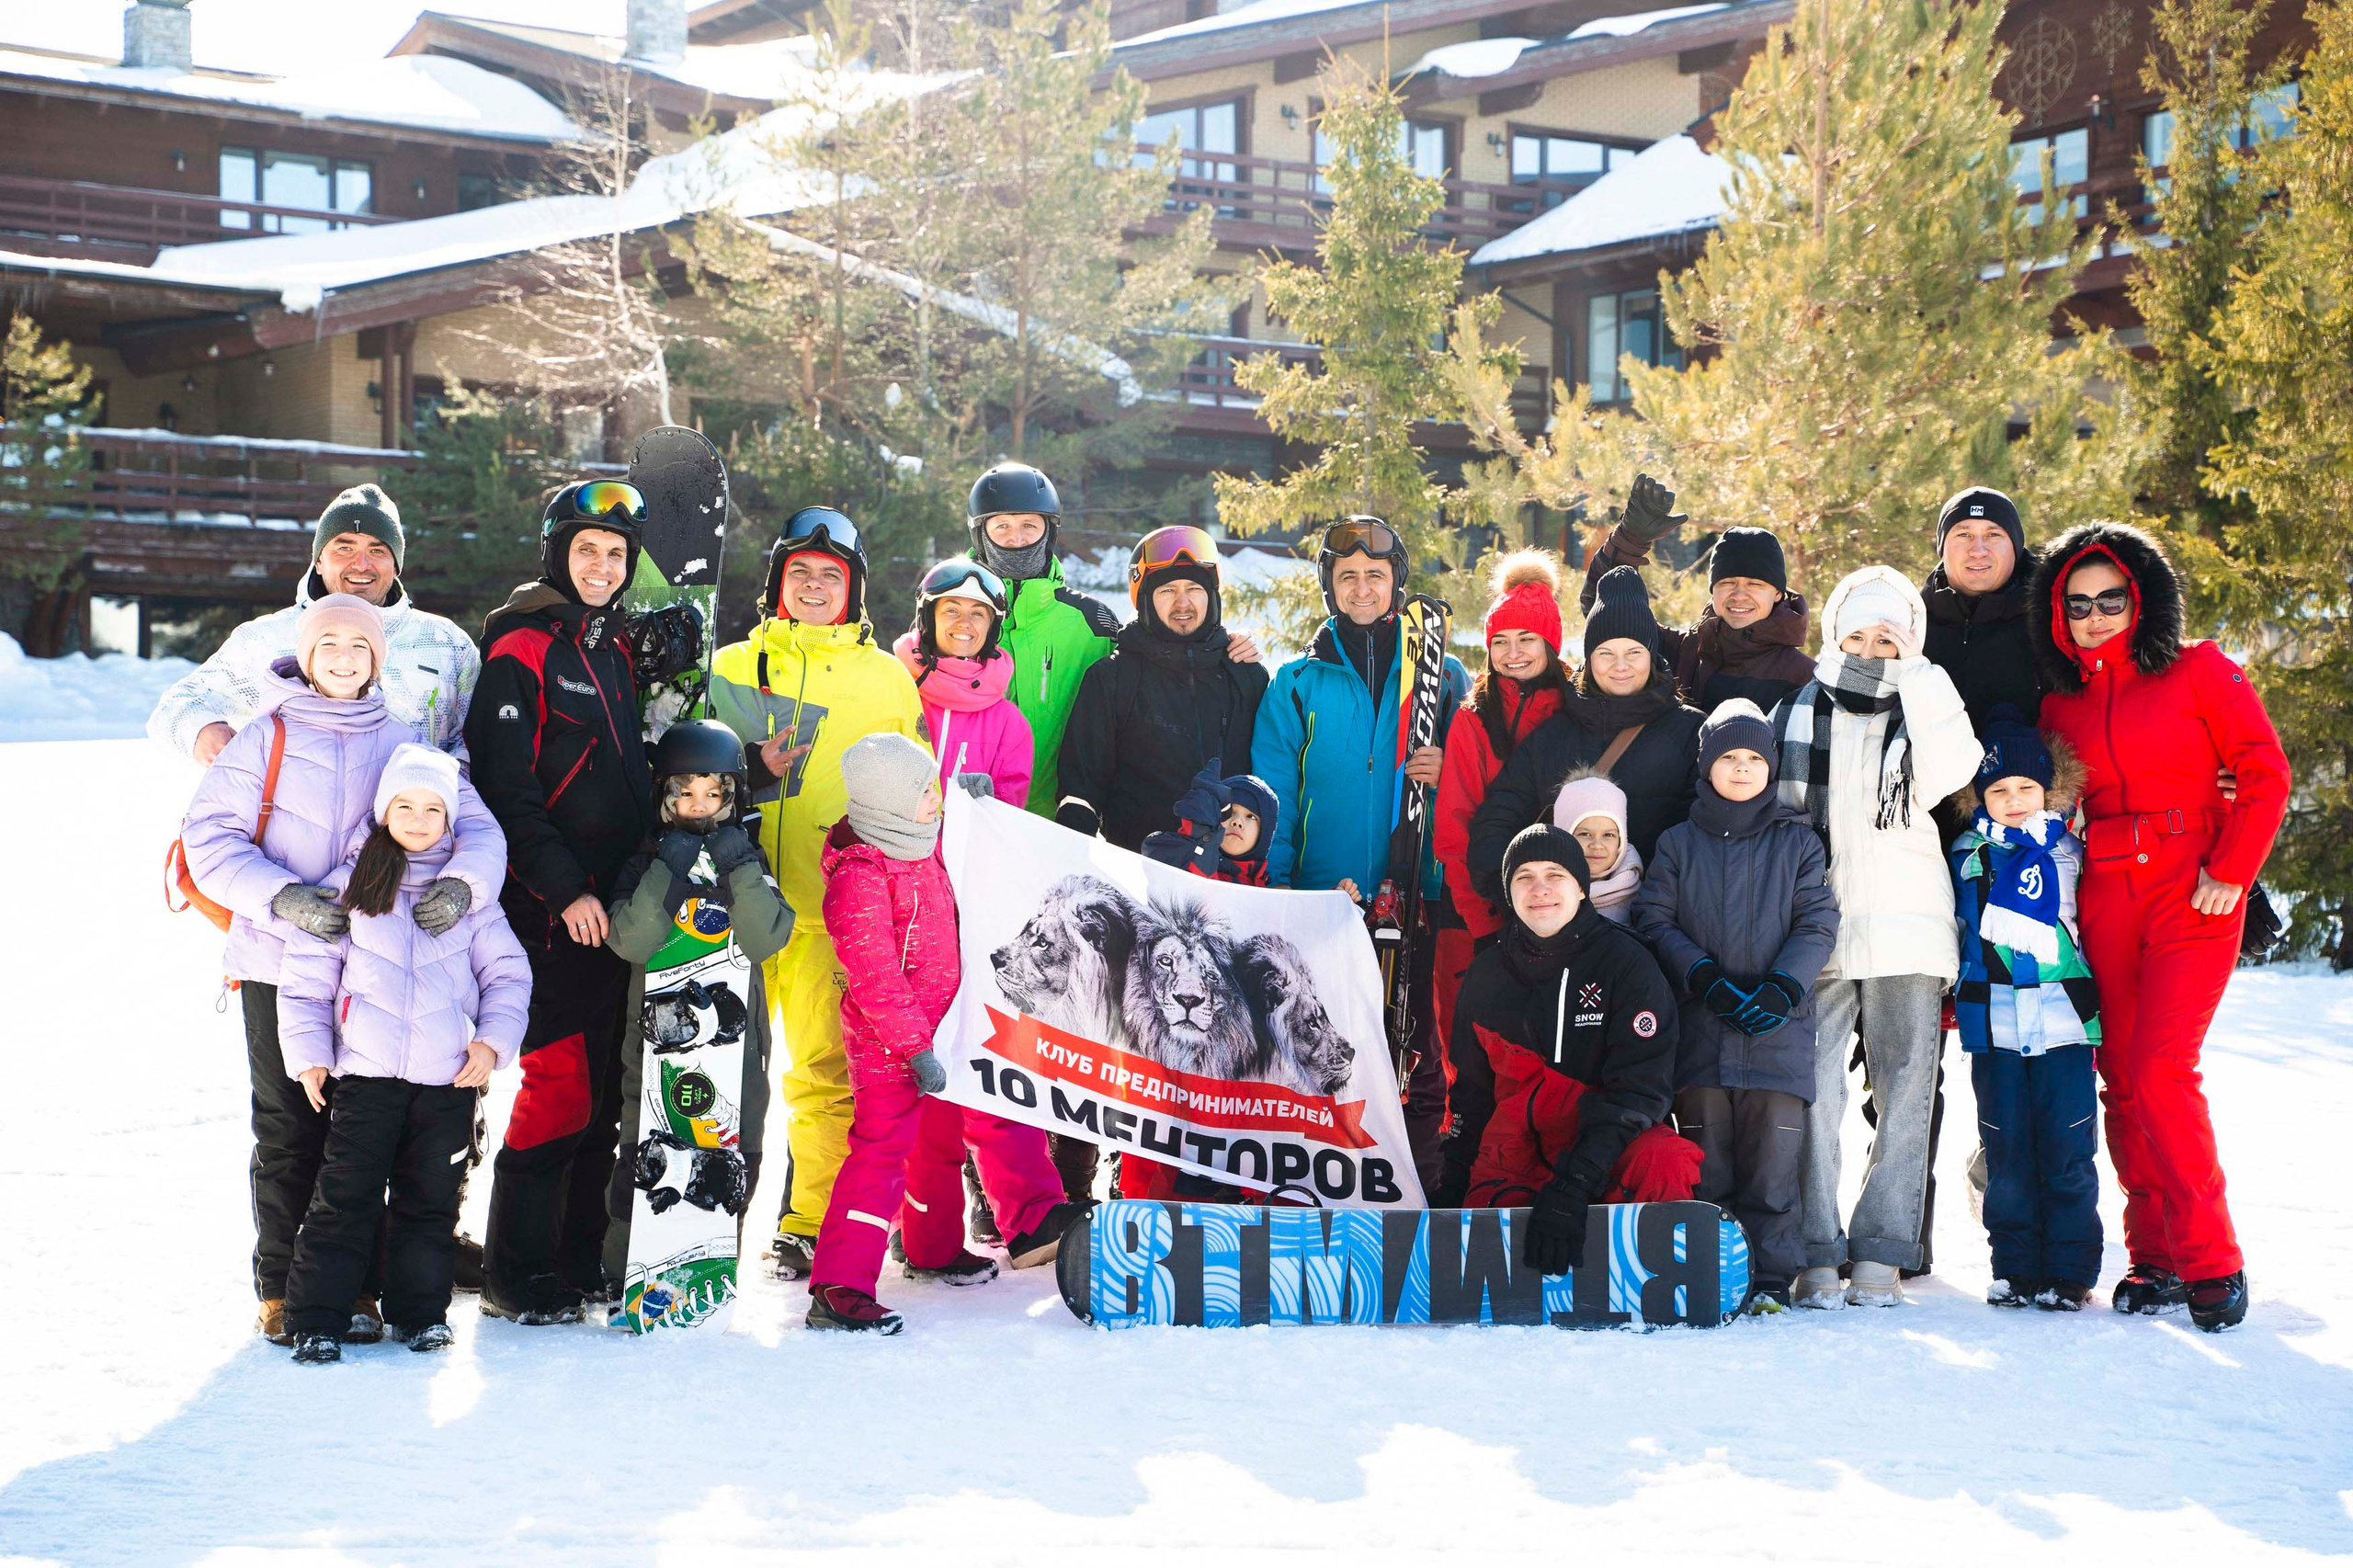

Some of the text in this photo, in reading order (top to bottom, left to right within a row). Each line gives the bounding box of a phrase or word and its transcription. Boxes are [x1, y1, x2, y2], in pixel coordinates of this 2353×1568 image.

[587, 627, 602, 649] SUP
[1408, 602, 1441, 834] SAOMON
[1574, 1013, 1604, 1022] SNOW
[969, 1058, 1038, 1108] 10
[1035, 1037, 1335, 1129] КЛУБ ПРЕДПРИНИМАТЕЛЕЙ
